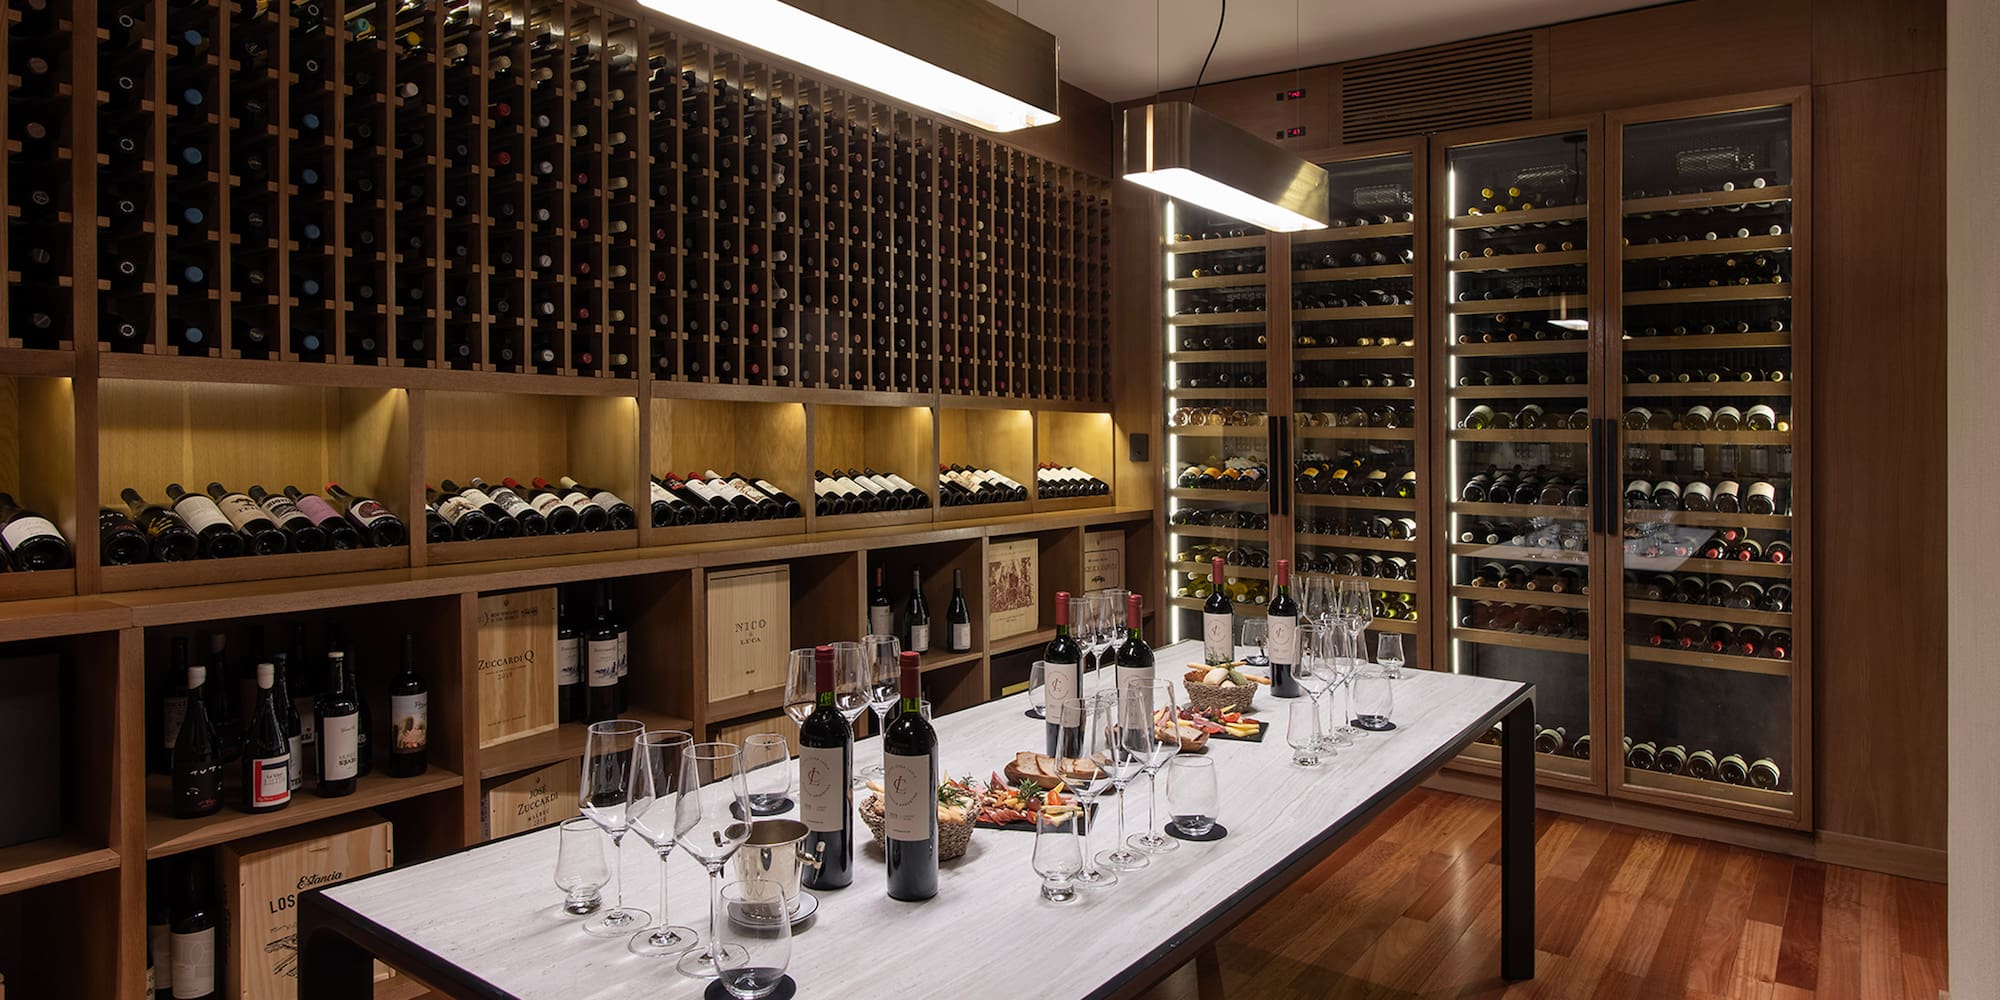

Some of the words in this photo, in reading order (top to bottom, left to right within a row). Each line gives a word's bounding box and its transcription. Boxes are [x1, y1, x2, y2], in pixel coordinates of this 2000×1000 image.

[735, 619, 767, 633] NICO
[740, 636, 761, 646] LUCA
[478, 655, 523, 671] ZUCCARDI
[524, 649, 535, 664] Q
[517, 791, 559, 816] ZUCCARDI
[296, 871, 343, 890] Estancia
[269, 894, 296, 914] LOS
